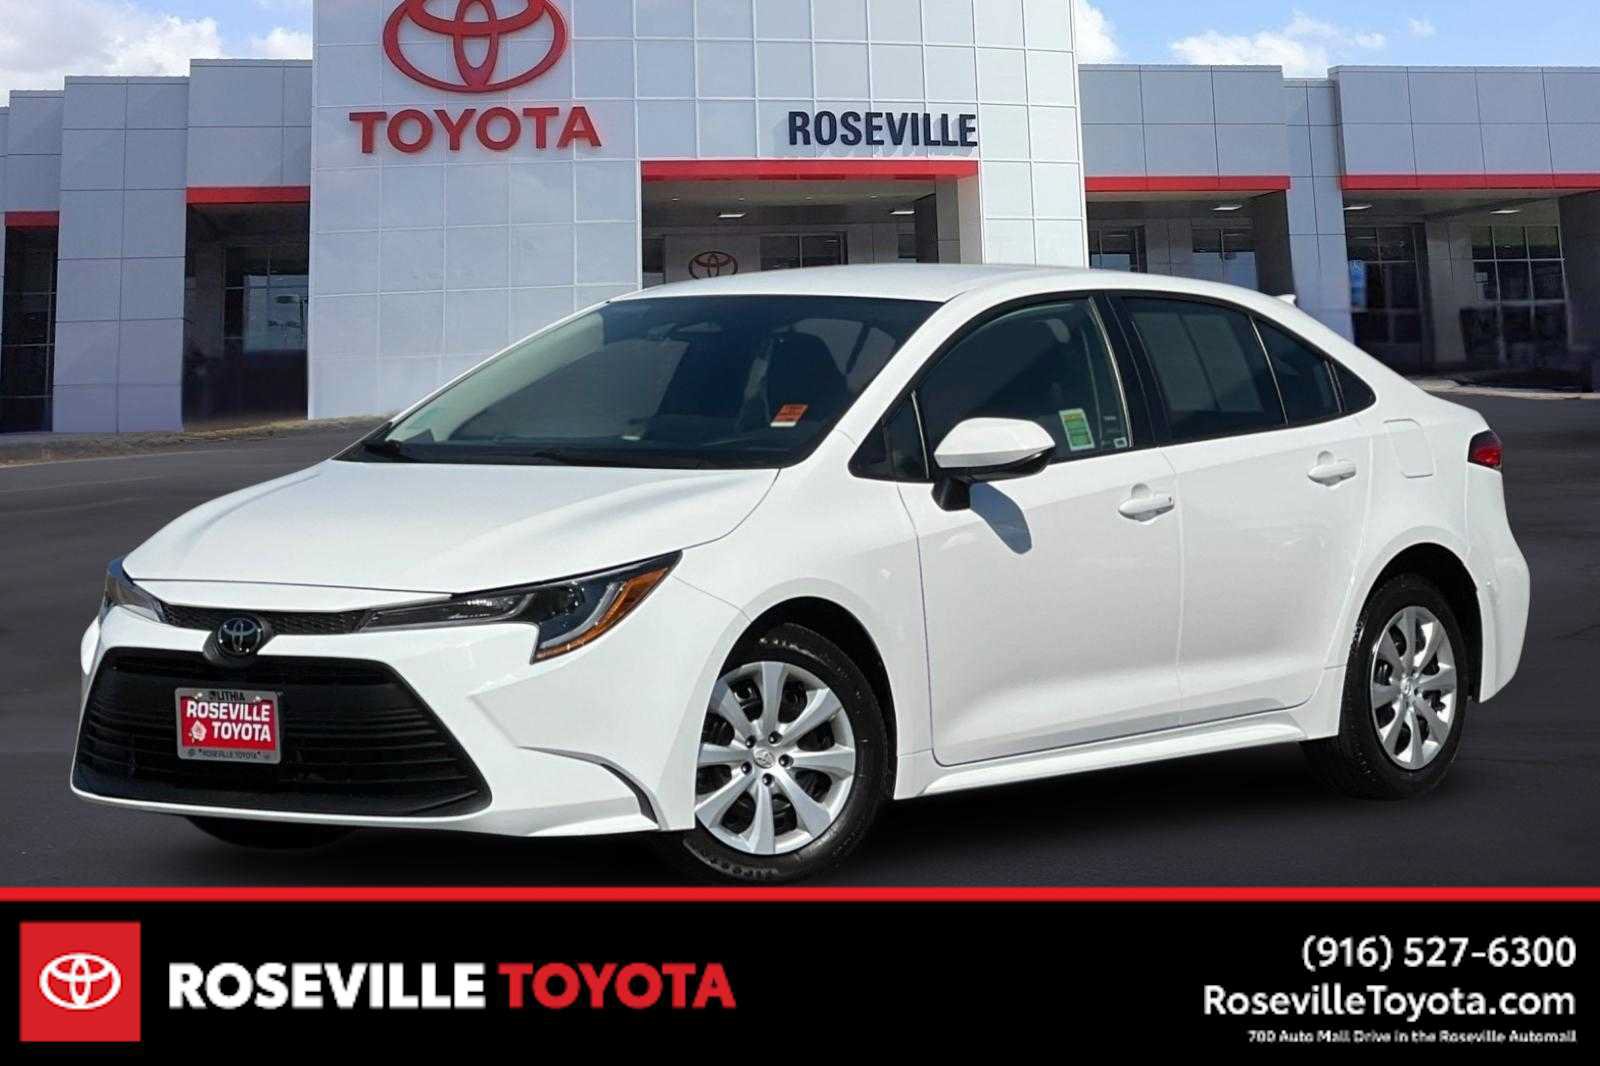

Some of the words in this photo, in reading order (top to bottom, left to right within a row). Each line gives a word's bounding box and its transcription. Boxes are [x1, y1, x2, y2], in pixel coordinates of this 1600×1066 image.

[349, 106, 602, 154] TOYOTA
[788, 111, 978, 148] ROSEVILLE
[217, 690, 246, 701] LITHIA
[186, 701, 271, 722] ROSEVILLE
[211, 721, 272, 742] TOYOTA
